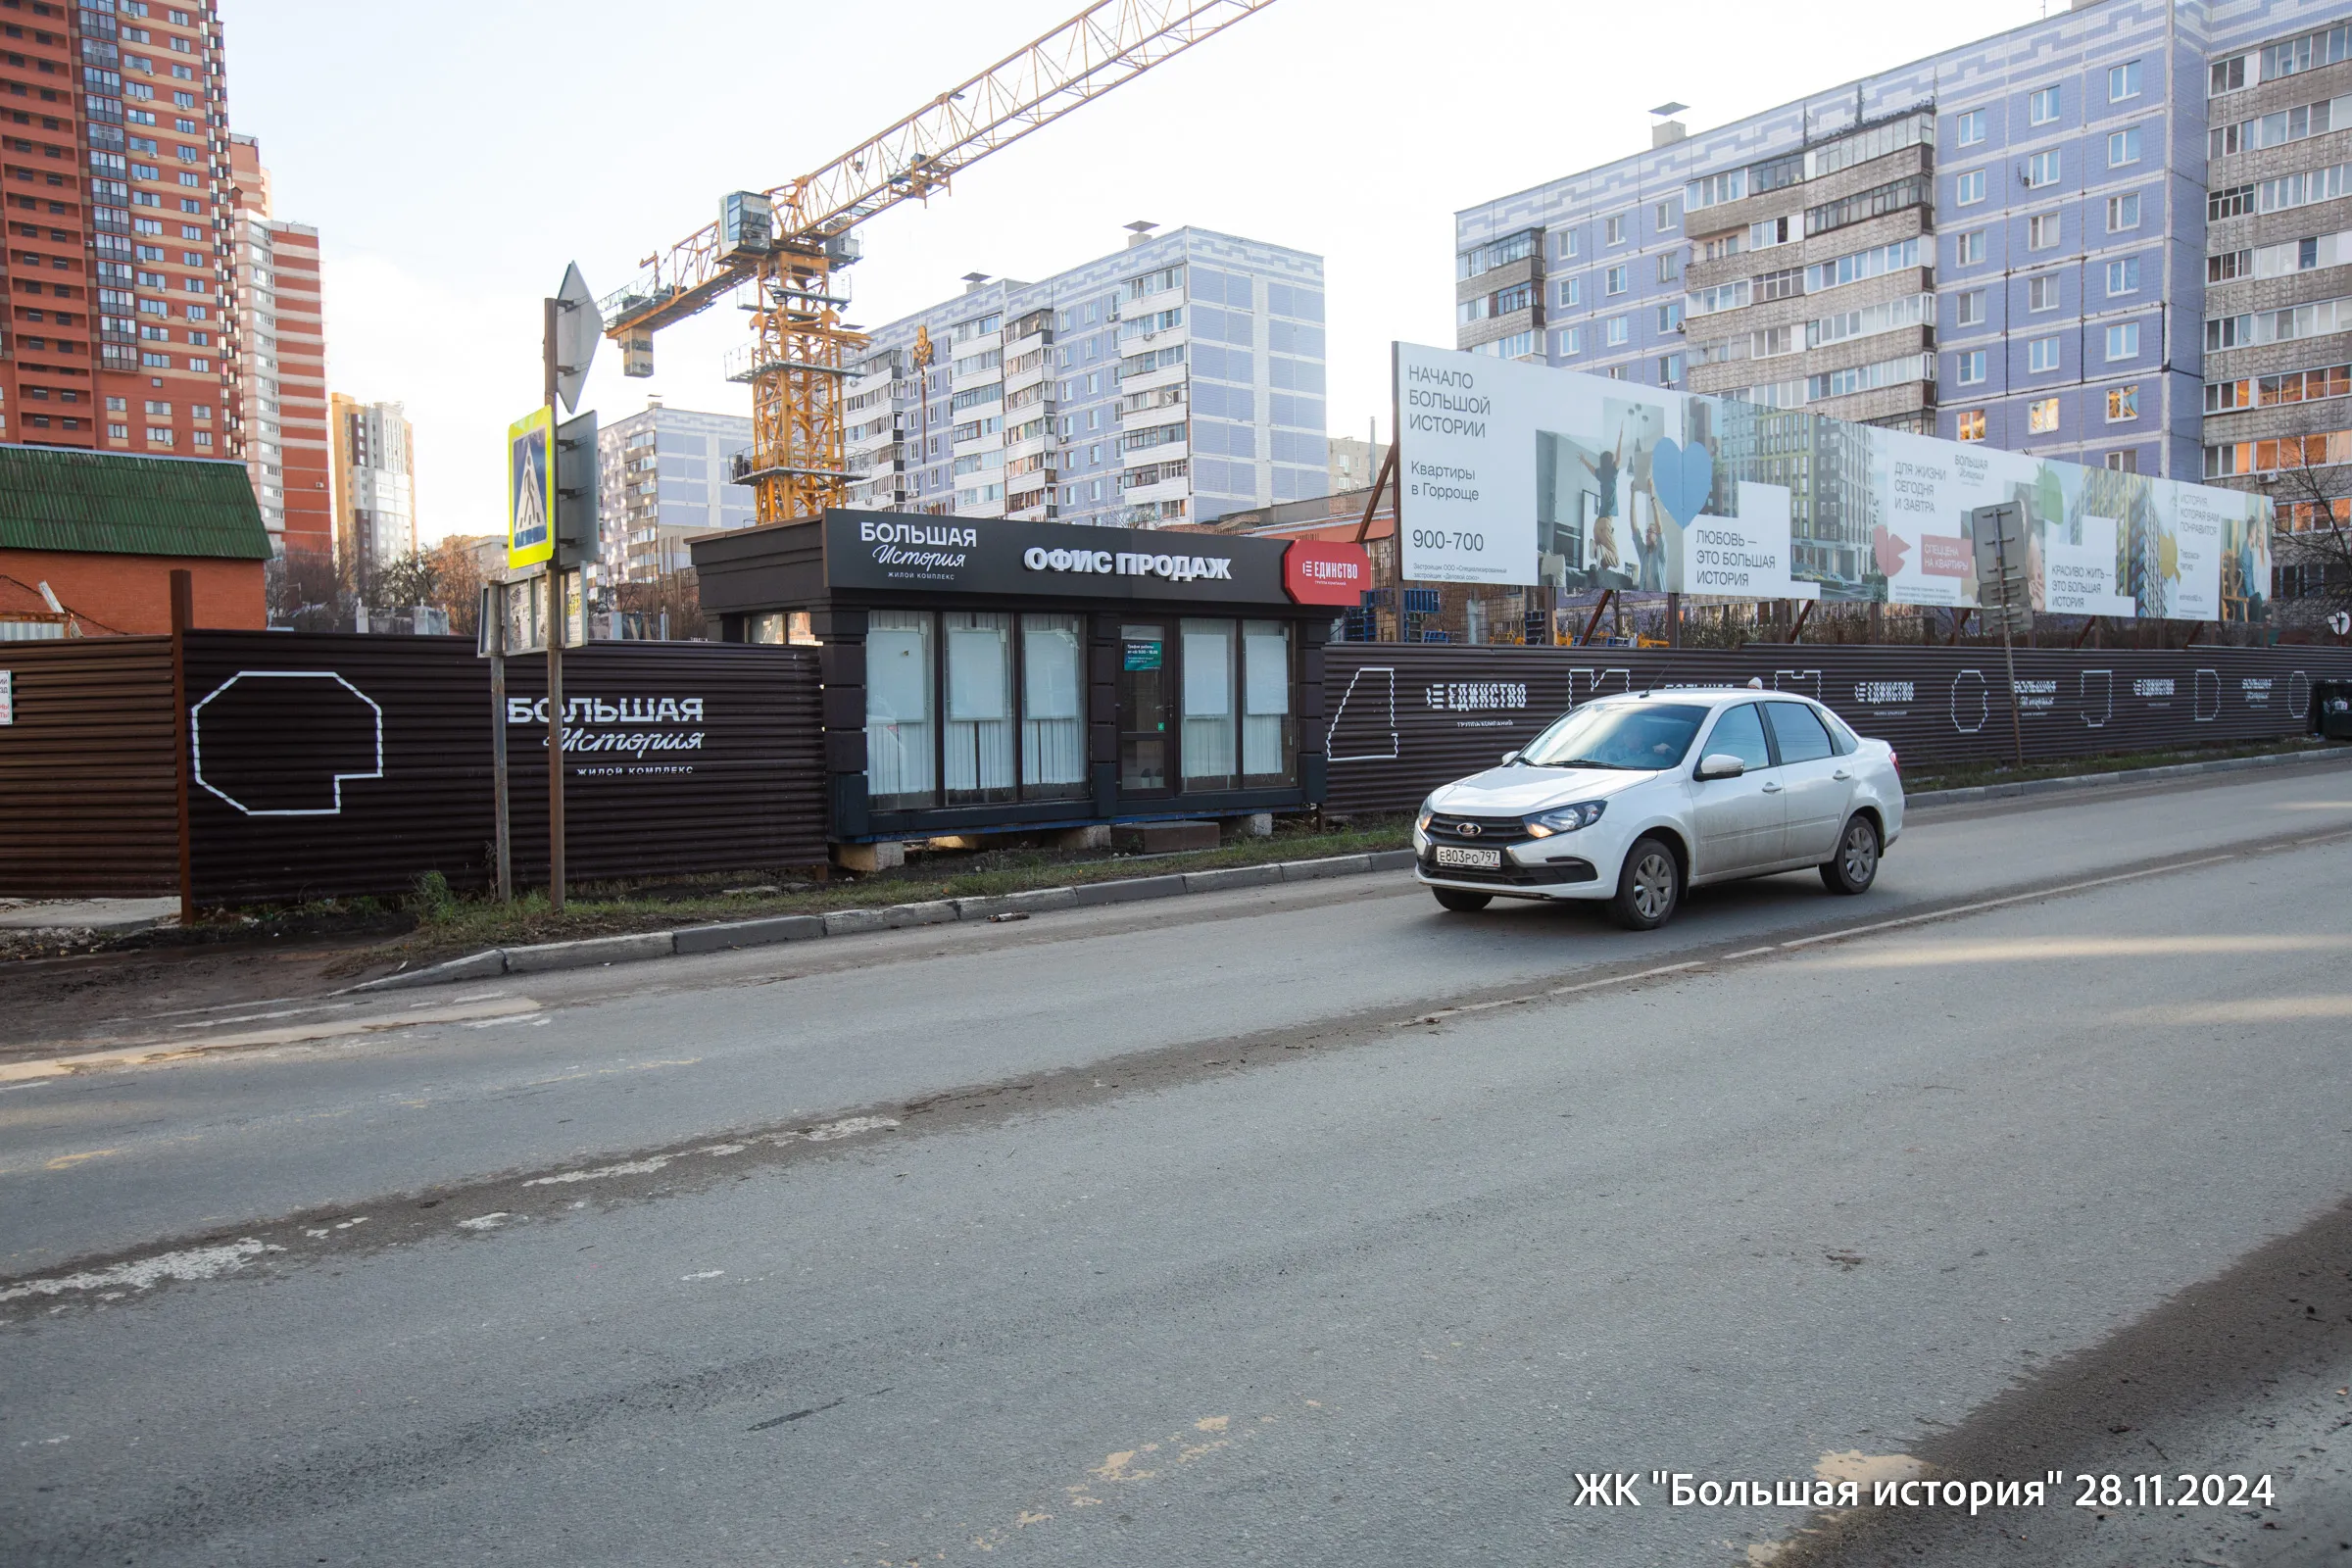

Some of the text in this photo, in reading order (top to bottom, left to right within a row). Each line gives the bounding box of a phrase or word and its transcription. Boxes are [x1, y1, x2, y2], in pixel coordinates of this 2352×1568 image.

[1408, 364, 1474, 389] НАЧАЛО
[1409, 389, 1491, 416] БОЛЬШОЙ
[1409, 413, 1486, 438] ИСТОРИИ
[1411, 461, 1476, 481] Квартиры
[1954, 454, 1988, 470] БОЛЬШАЯ
[1894, 462, 1946, 481] ДЛЯ ЖИЗНИ
[1411, 482, 1480, 502] в Горроще
[1894, 479, 1935, 497] СЕГОДНЯ
[1894, 497, 1936, 514] И ЗАВТРА
[860, 521, 977, 547] БОЛЬШАЯ
[1412, 529, 1484, 552] 900-700
[1695, 529, 1745, 547] ЛЮБОВЬ
[872, 545, 966, 571] История
[1696, 549, 1776, 568] ЭТО БОЛЬШАЯ
[1924, 543, 1959, 558] СПЕЦЦЕНА
[1023, 547, 1233, 582] ОФИС ПРОДАЖ
[1314, 561, 1358, 579] ЕДИНСТВО
[1413, 563, 1443, 571] Застройщик
[1924, 558, 1969, 571] НА КВАРТИРЫ
[2052, 564, 2084, 578] КРАСИВО
[2084, 567, 2105, 579] ЖИТЬ
[1696, 570, 1749, 587] ИСТОРИЯ
[2052, 580, 2102, 594] ЭТО БОЛЬШАЯ
[2052, 596, 2084, 609] ИСТОРИЯ
[1447, 683, 1527, 711] ЕДИНСТВО
[508, 697, 704, 723] БОЛЬШАЯ
[576, 765, 694, 776] ЖИЛОЙ КОМПЛЕКС
